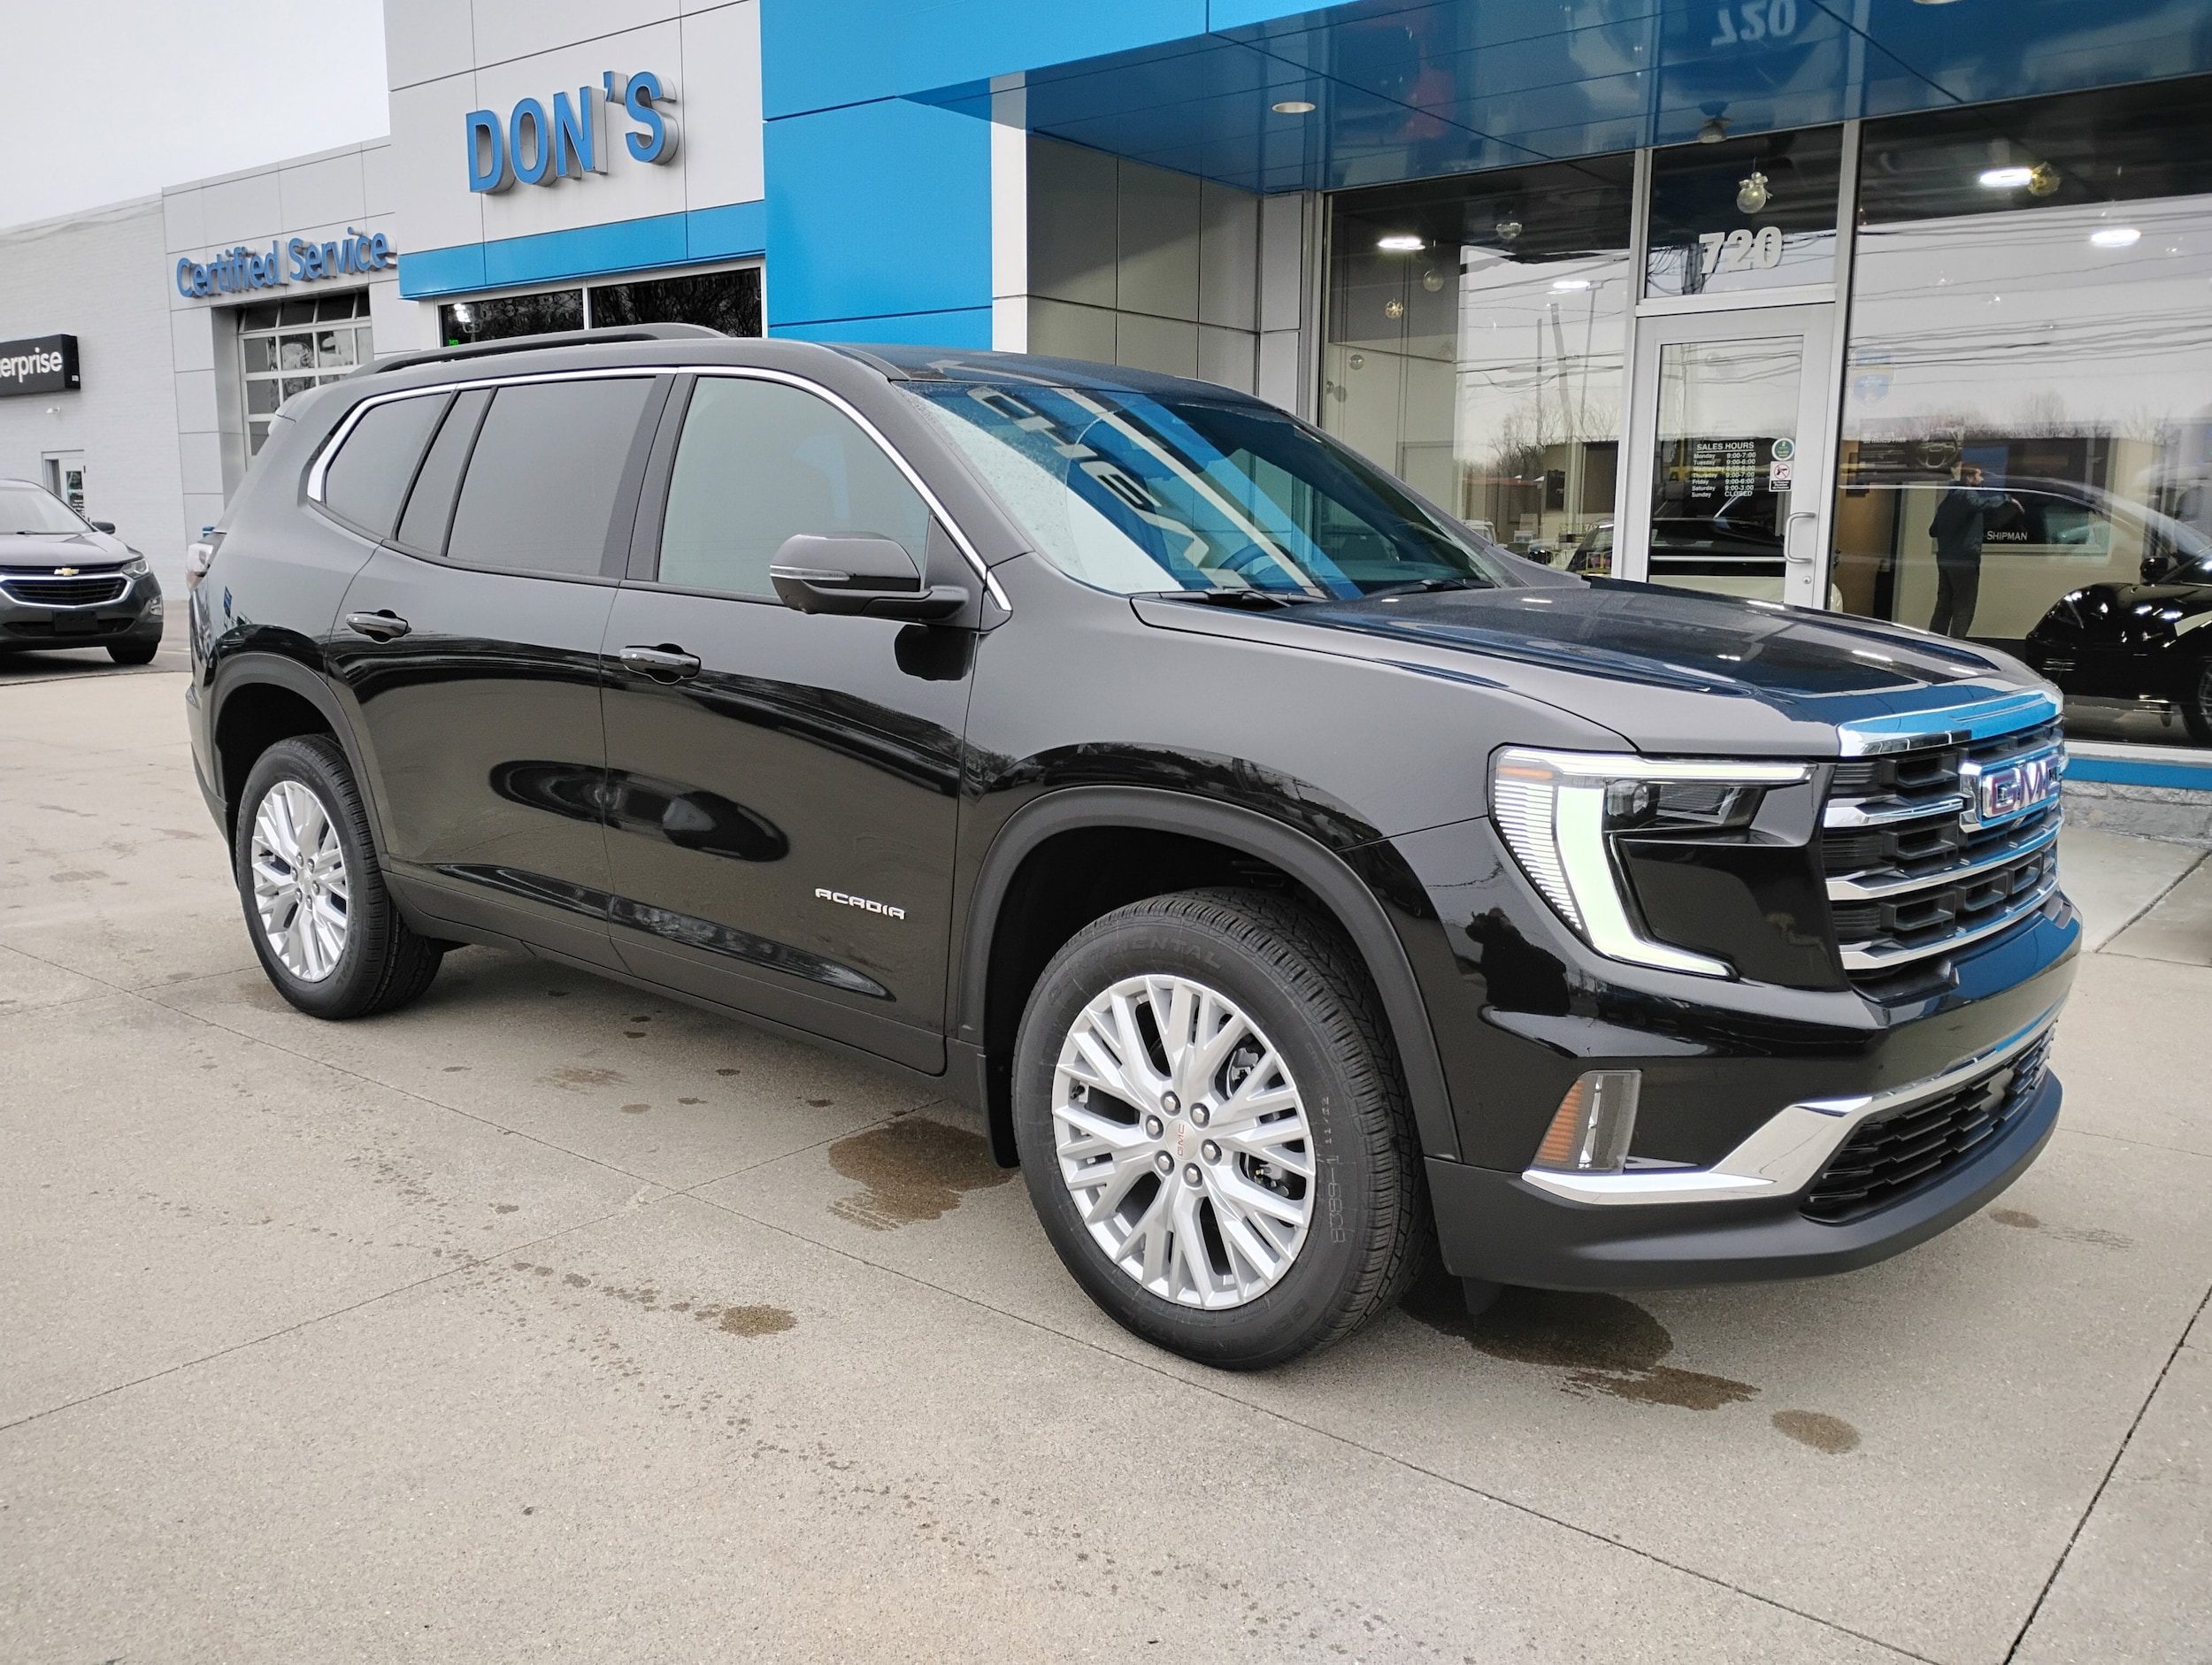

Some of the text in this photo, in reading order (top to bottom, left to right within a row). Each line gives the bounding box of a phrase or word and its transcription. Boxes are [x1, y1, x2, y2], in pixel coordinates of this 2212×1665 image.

[466, 71, 677, 193] DON'S
[177, 226, 393, 298] Certified Service
[1699, 226, 1782, 274] 720
[0, 347, 63, 383] erprise
[1986, 531, 2028, 541] SHIPMAN
[1982, 754, 2062, 818] GMC
[815, 888, 906, 920] ACADIA
